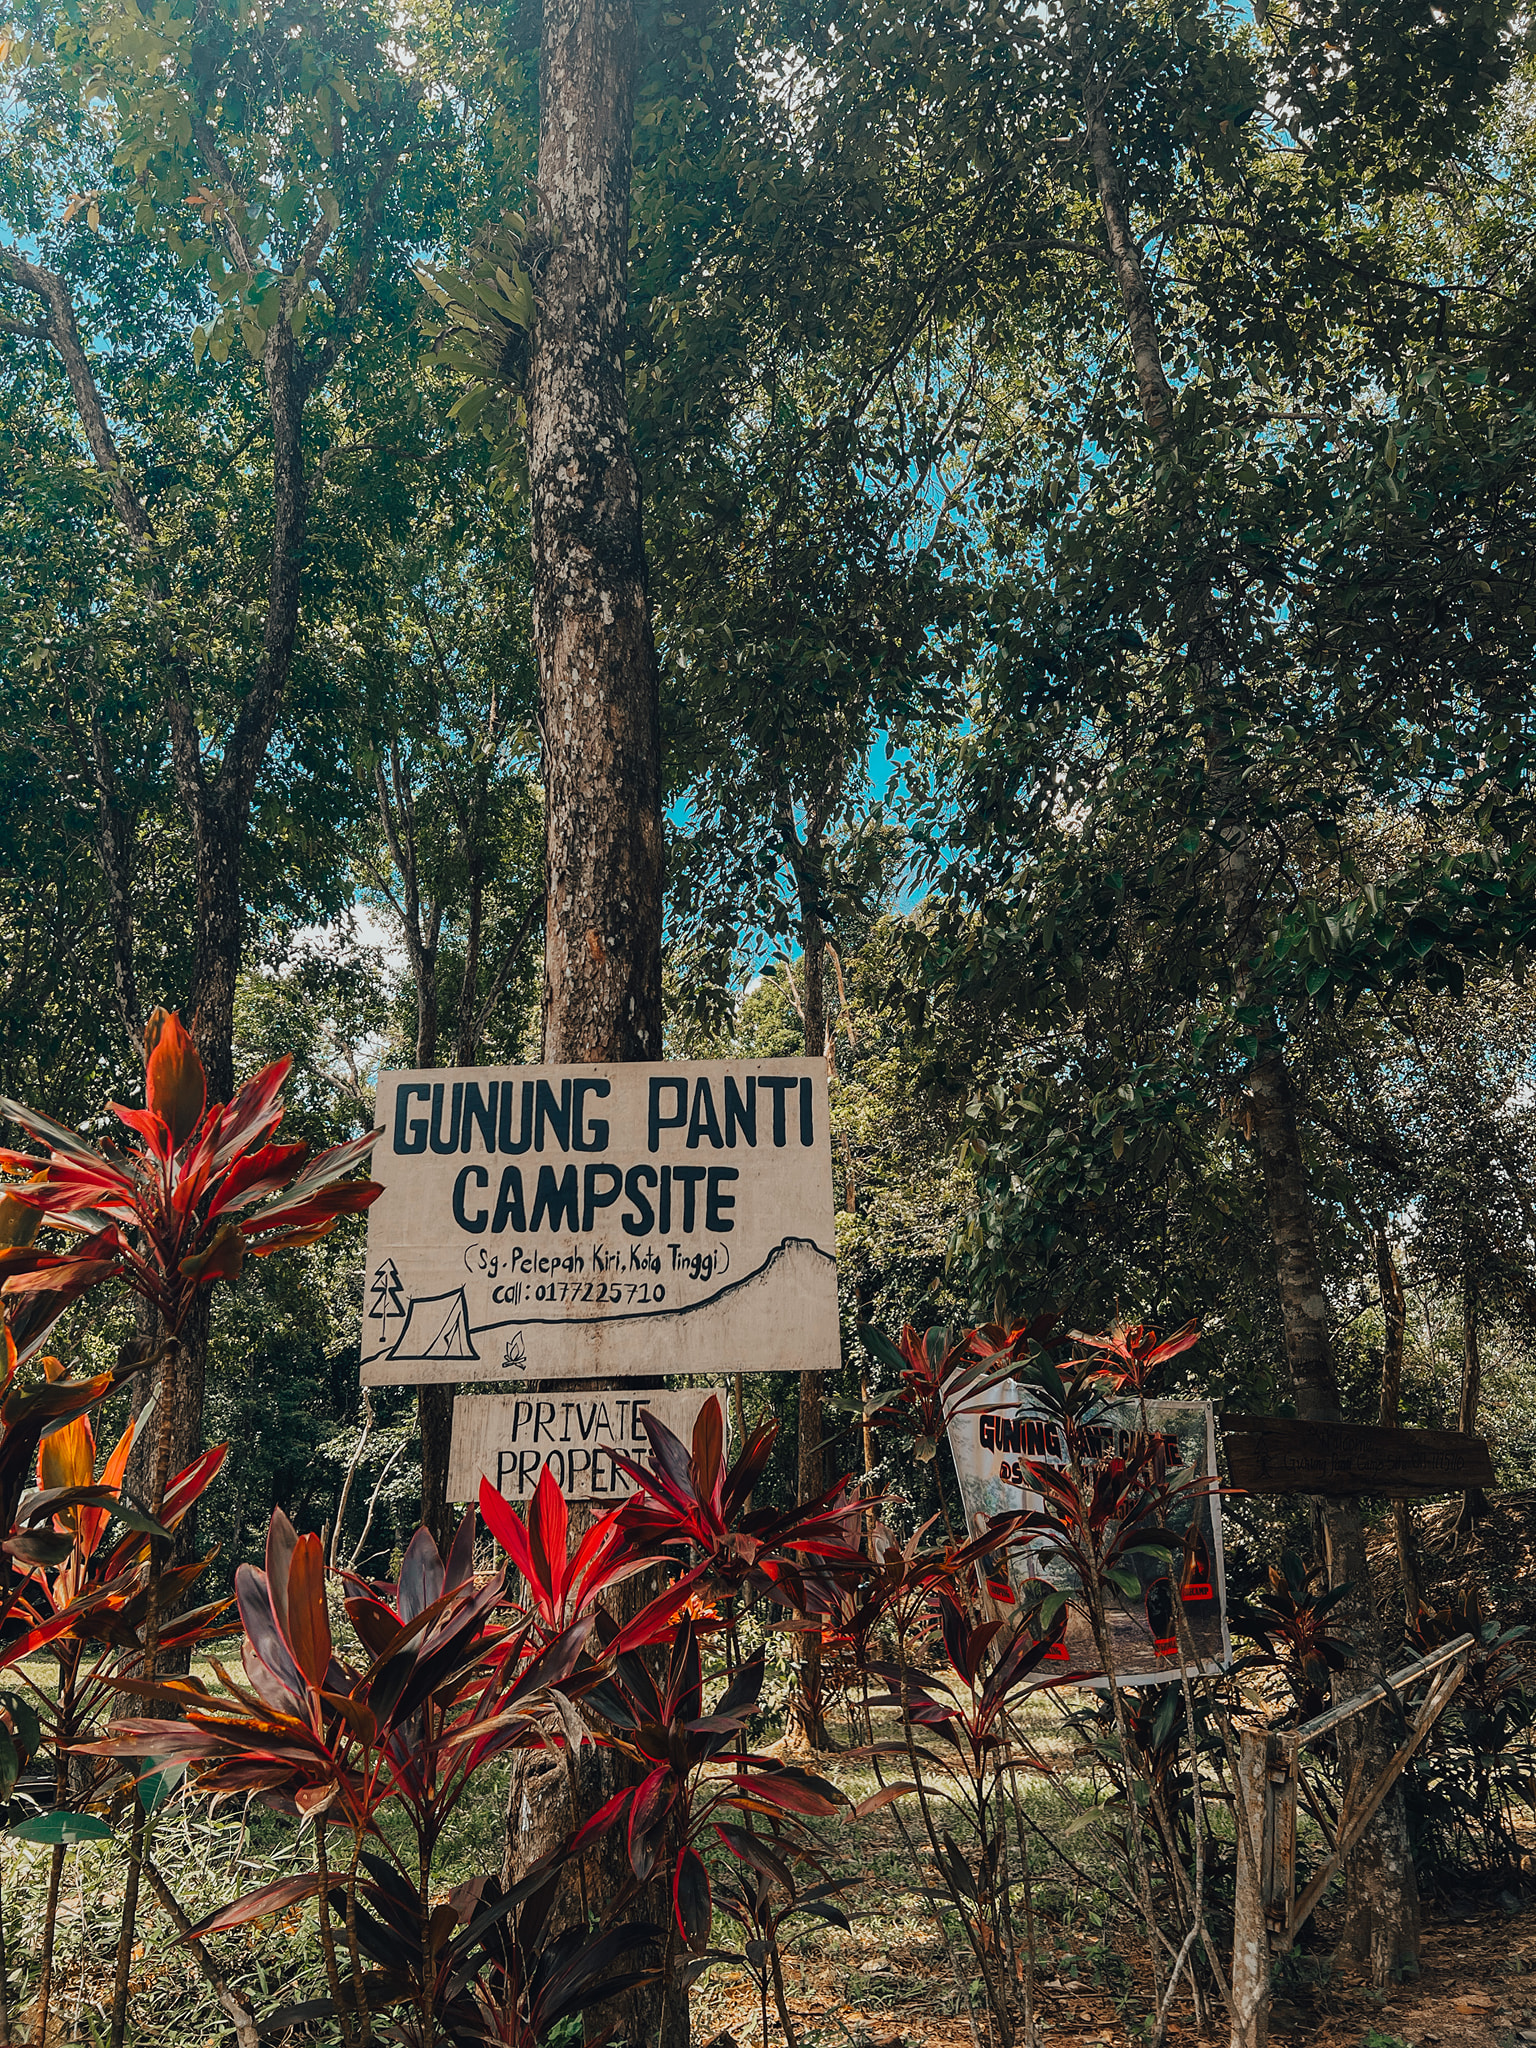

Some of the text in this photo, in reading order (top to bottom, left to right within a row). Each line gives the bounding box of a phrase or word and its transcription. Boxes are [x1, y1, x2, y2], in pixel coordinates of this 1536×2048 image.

[393, 1075, 815, 1155] GUNUNG PANTI
[452, 1164, 740, 1236] CAMPSITE
[667, 1242, 730, 1281] Tinggi)
[535, 1282, 666, 1305] 0177225710
[511, 1400, 651, 1443] PRIVATE
[497, 1448, 656, 1494] PROPERT
